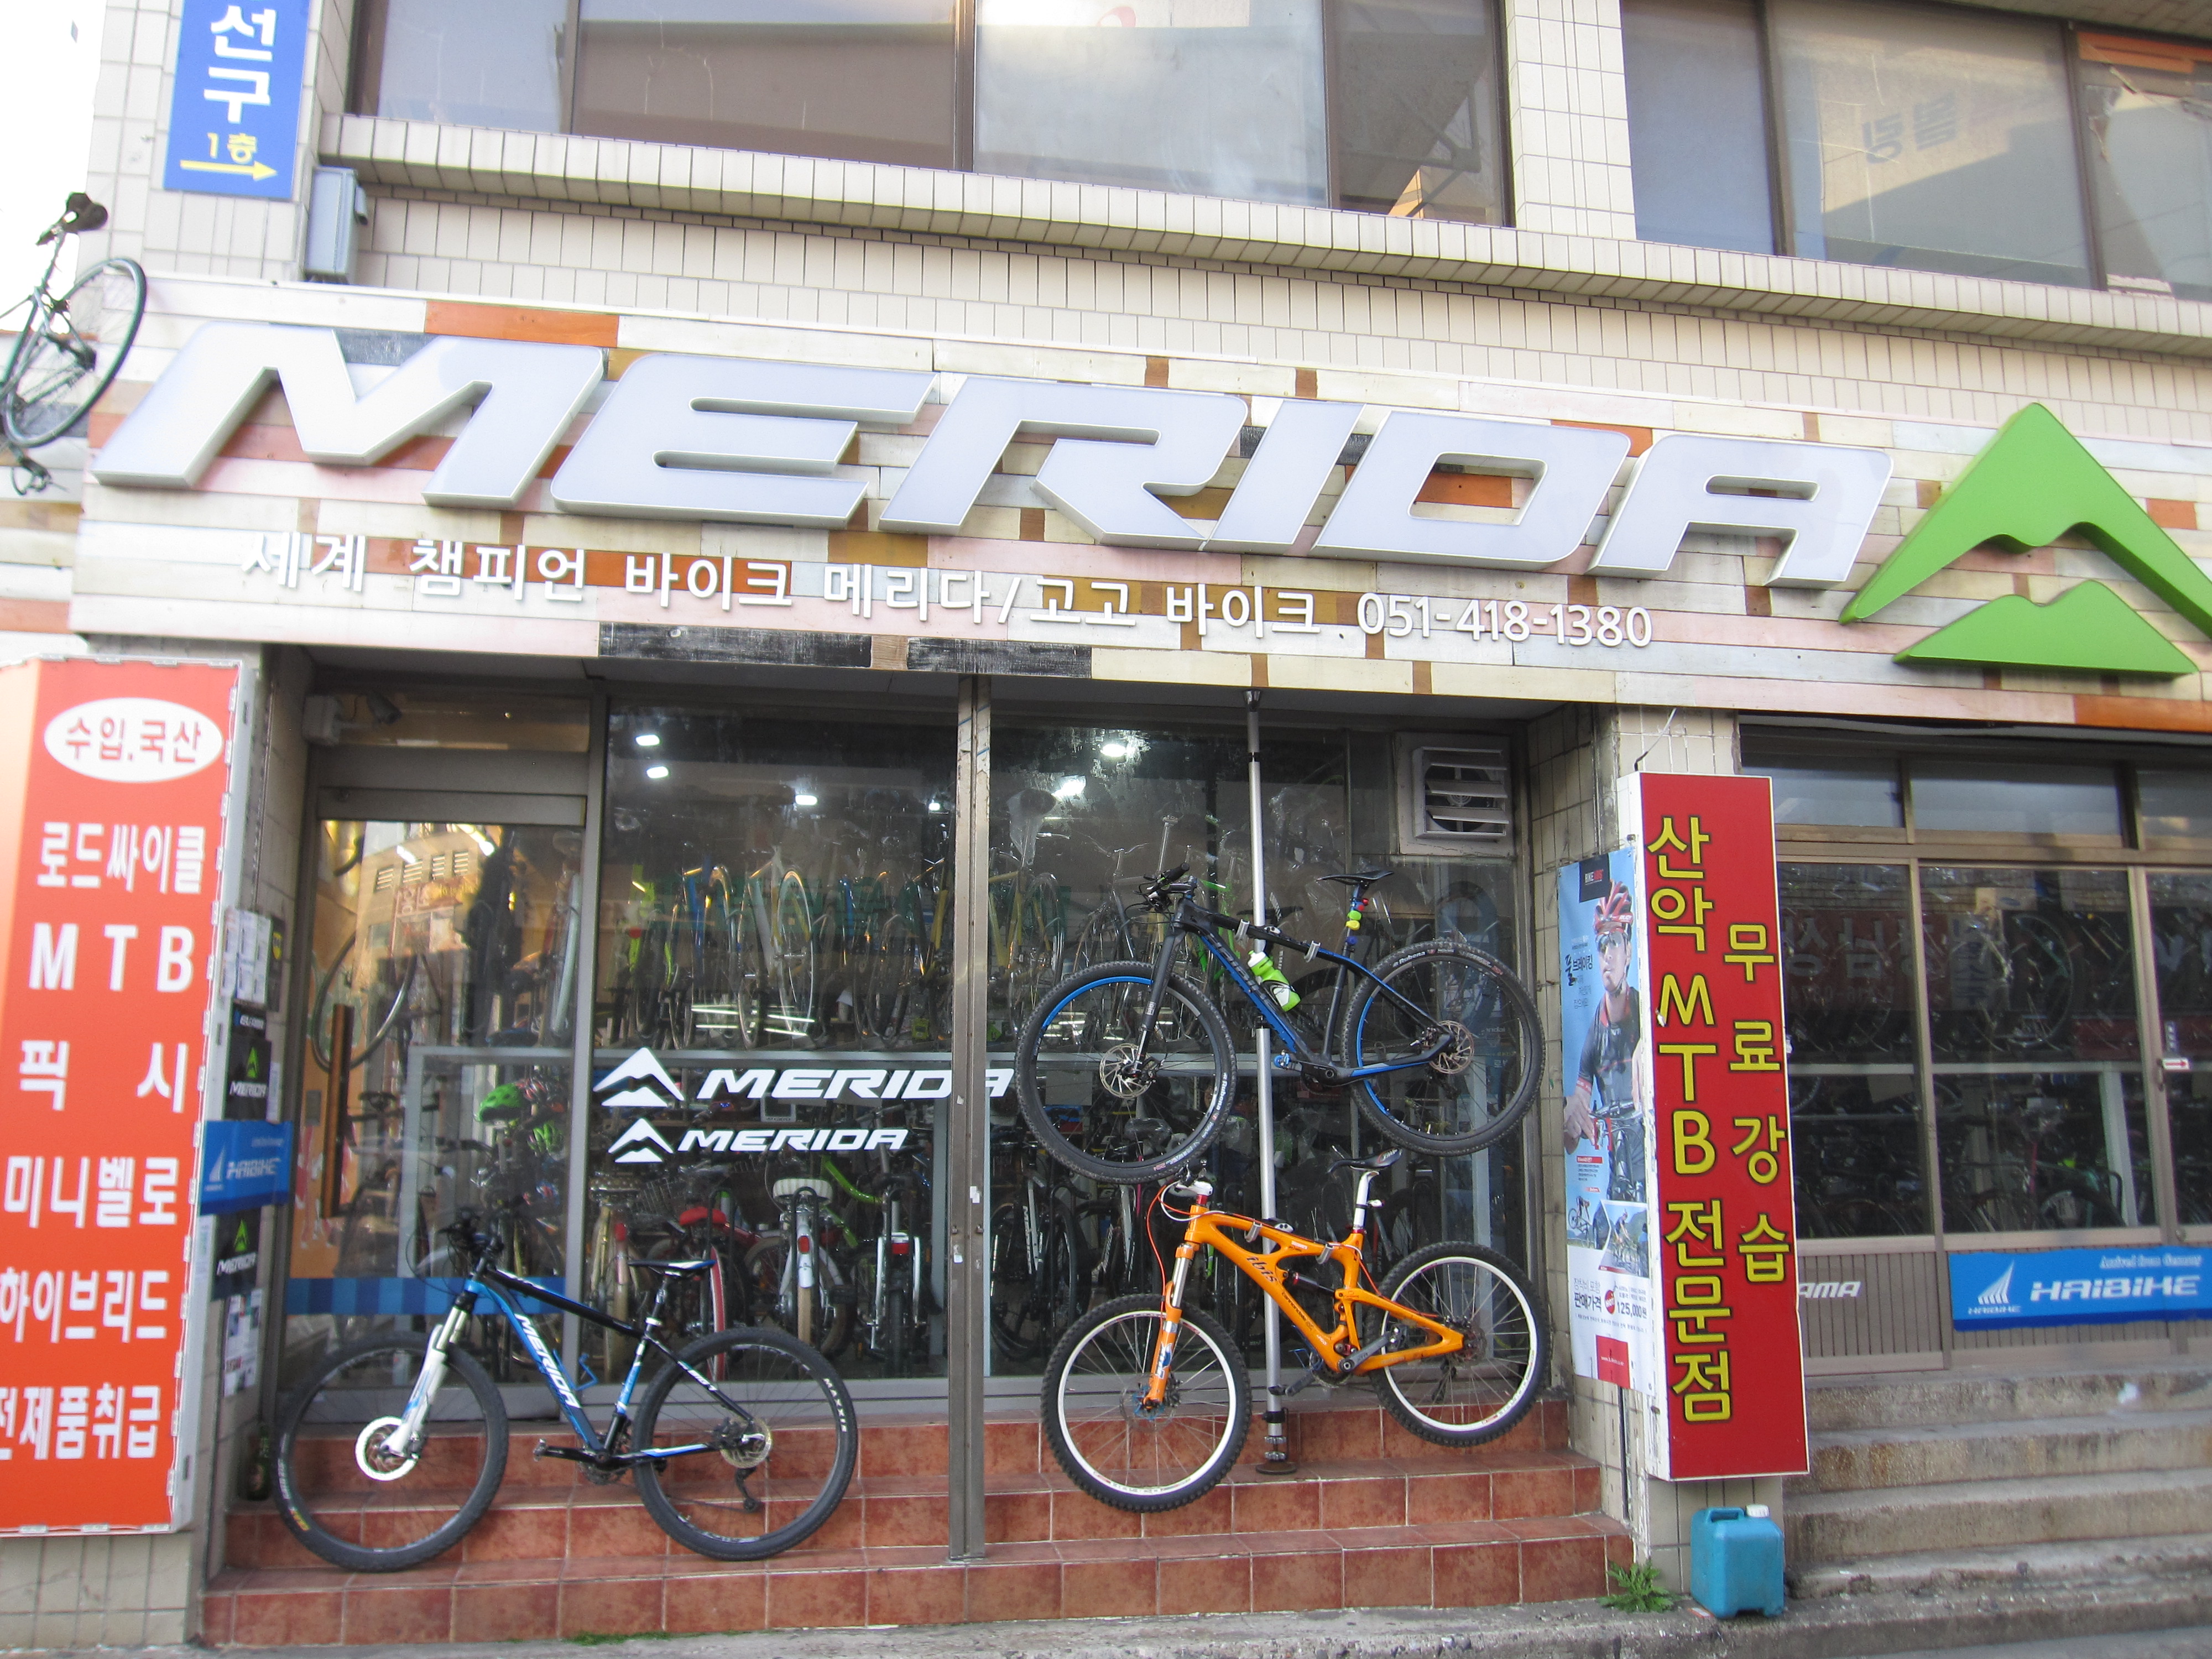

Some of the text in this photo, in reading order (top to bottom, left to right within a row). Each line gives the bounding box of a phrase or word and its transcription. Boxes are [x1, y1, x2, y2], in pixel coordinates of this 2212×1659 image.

[207, 133, 258, 164] 1층
[91, 321, 1894, 588] MERIDA
[242, 531, 366, 592] 세계
[409, 539, 586, 602] 챔피언
[625, 552, 792, 612] 바이크
[1166, 583, 1321, 638] 바이크
[1357, 592, 1652, 648] 051-418-1380
[65, 717, 202, 763] 수입.국산
[36, 822, 206, 894] 로드싸이클
[697, 1068, 1015, 1099] MERIDA
[677, 1129, 908, 1152] MERIDA
[4, 1156, 179, 1229] 미니벨로
[1246, 1256, 1279, 1282] ibis
[2030, 1275, 2201, 1301] HAIBIKE
[0, 1267, 170, 1343] 하이브리드
[514, 1313, 583, 1409] MERIDA
[823, 1378, 847, 1433] MAXXIS
